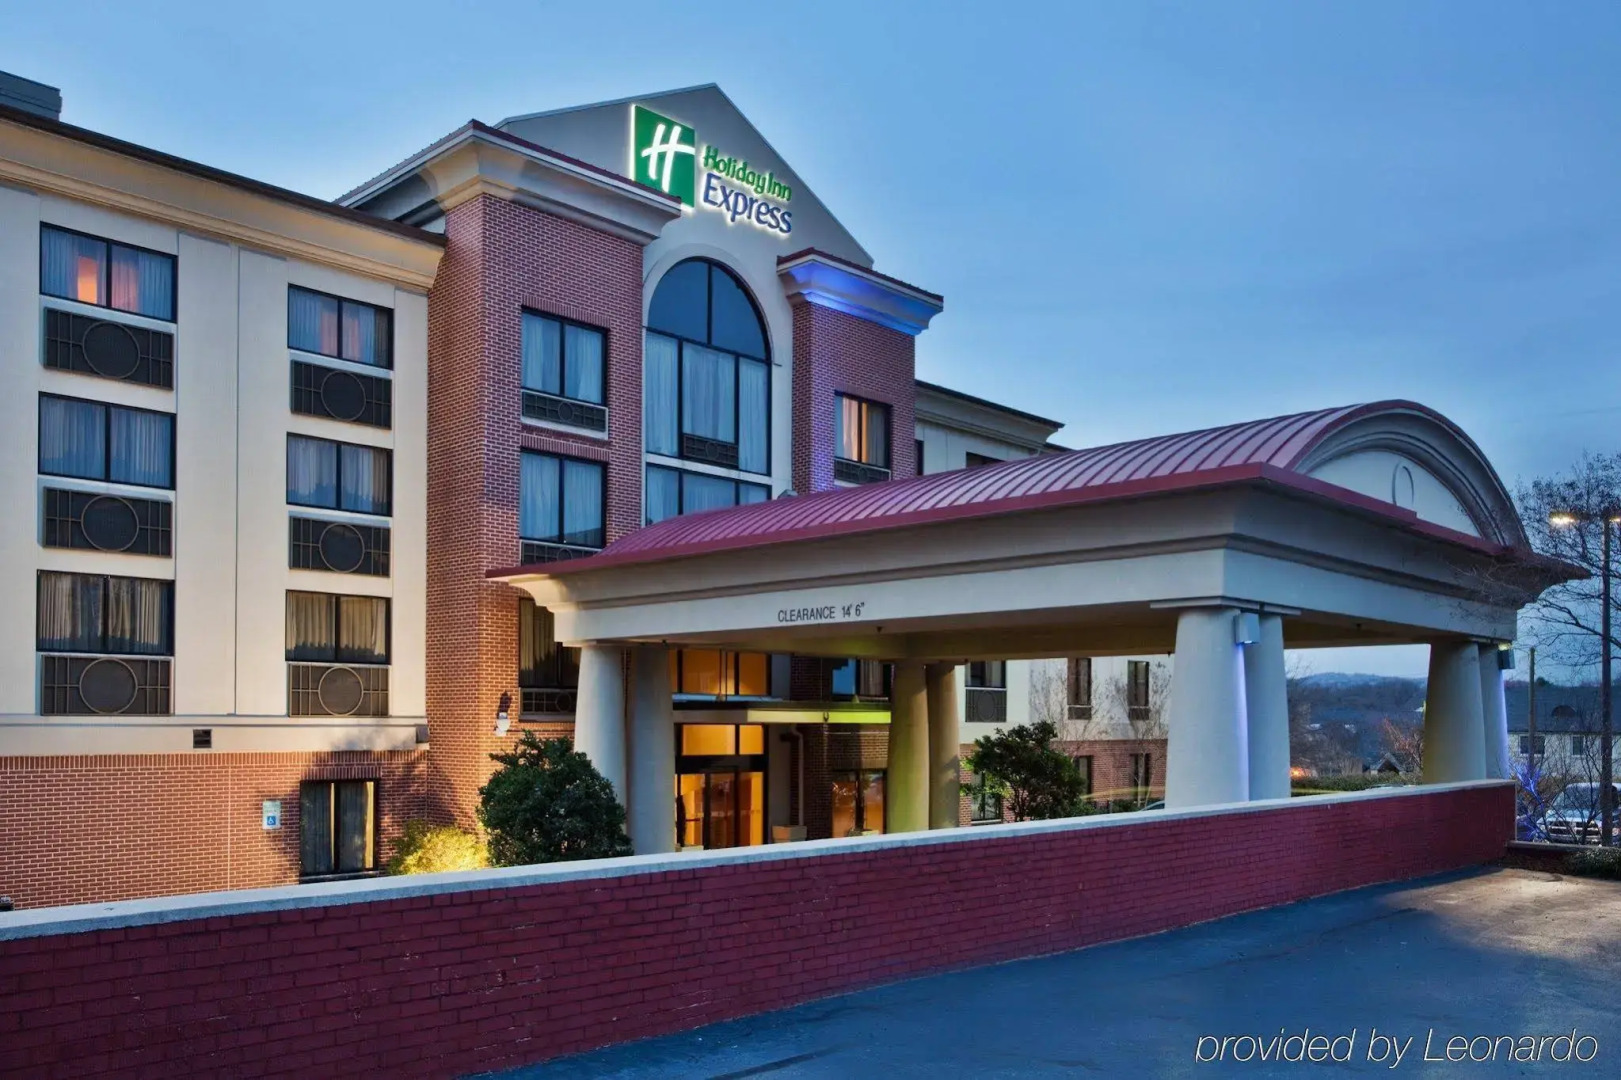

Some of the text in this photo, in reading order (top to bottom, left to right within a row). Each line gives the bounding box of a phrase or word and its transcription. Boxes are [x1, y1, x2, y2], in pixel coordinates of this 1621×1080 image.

[703, 145, 793, 202] Holiday Inn
[703, 172, 793, 234] Express
[777, 606, 836, 622] CLEARANCE
